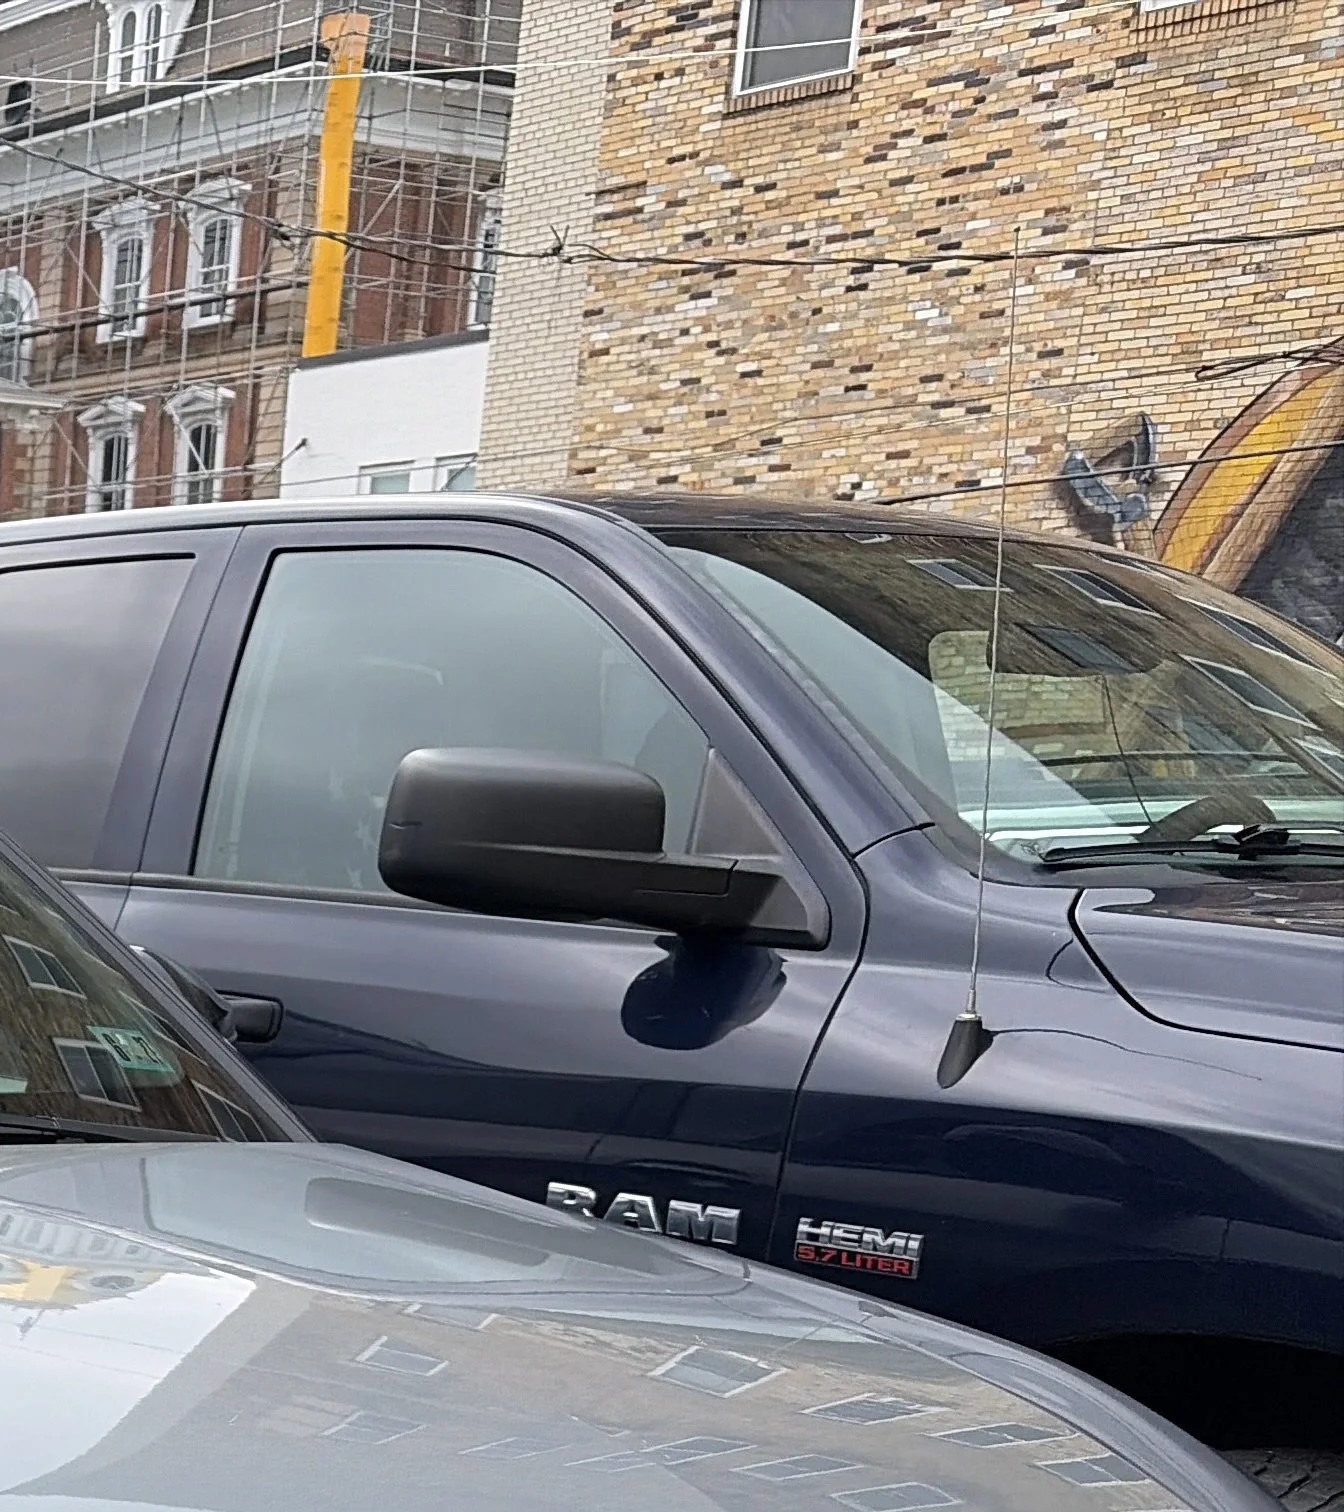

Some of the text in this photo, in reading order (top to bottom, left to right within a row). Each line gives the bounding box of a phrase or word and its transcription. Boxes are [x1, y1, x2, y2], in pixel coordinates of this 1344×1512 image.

[546, 1181, 742, 1246] RAM
[796, 1217, 925, 1258] HEMI
[797, 1244, 911, 1275] 5.7 LITER
